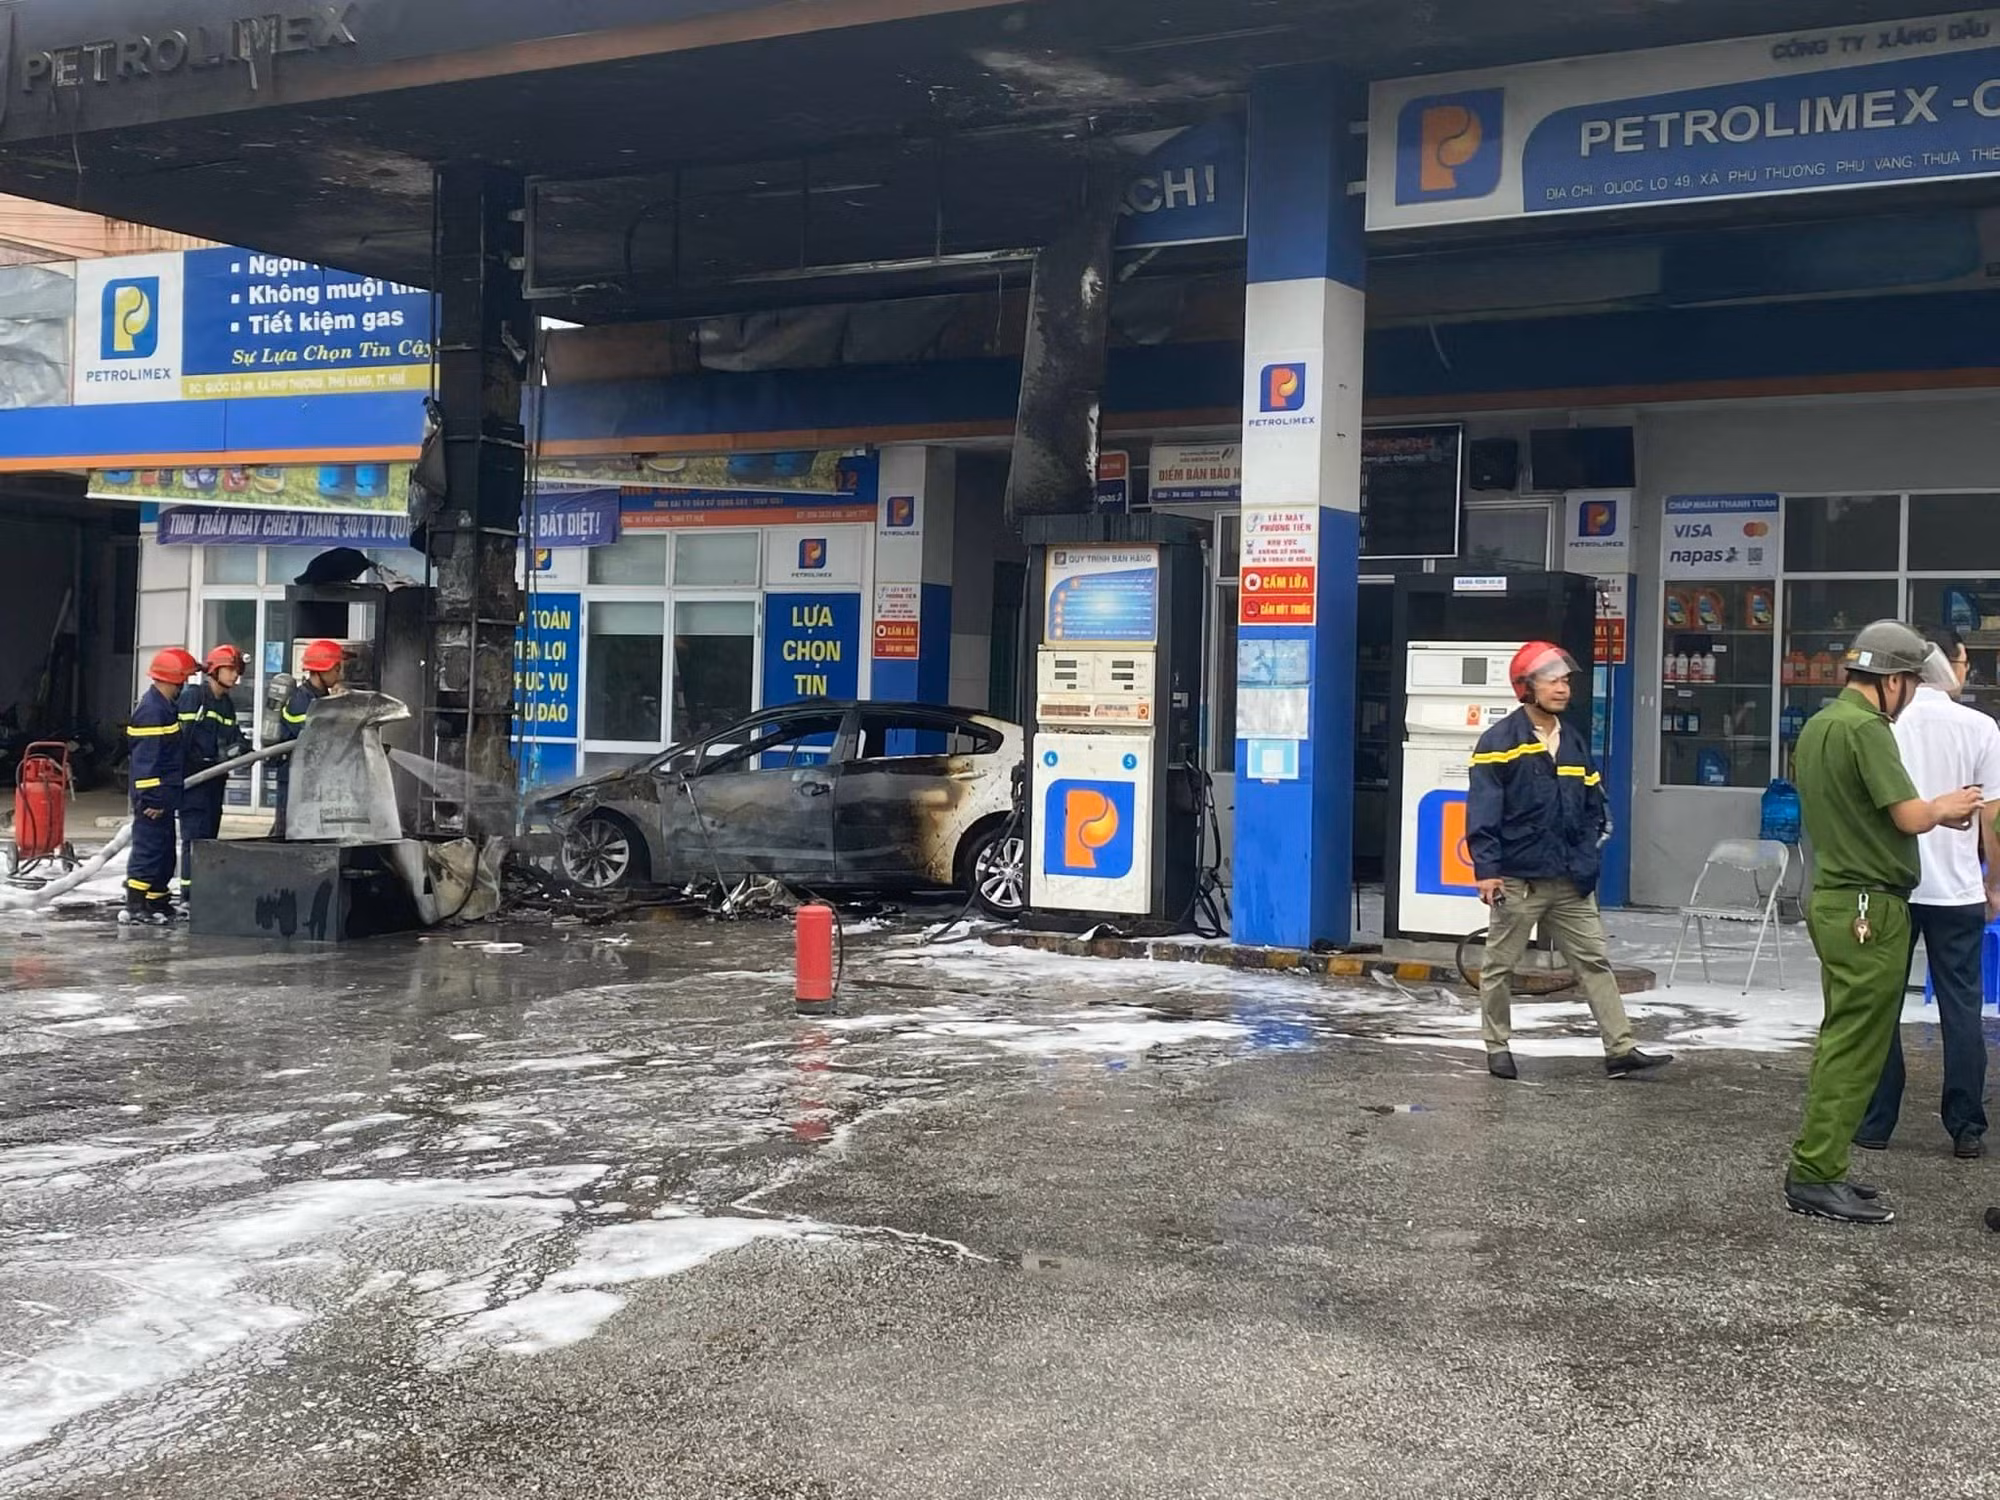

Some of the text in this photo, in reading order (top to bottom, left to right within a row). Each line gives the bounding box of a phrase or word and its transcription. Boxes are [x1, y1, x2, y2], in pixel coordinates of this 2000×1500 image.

[20, 3, 357, 93] PETROLIMEX
[1838, 34, 1866, 53] TY
[1579, 85, 1941, 157] PETROLIMEX
[1120, 164, 1215, 216] CH!
[249, 283, 320, 305] Không
[326, 276, 384, 302] muội
[248, 309, 405, 336] Tiết kiệm gas
[232, 348, 258, 367] Sự
[261, 347, 298, 366] Lựa
[303, 343, 353, 363] Chọn
[359, 341, 391, 358] Tin
[86, 368, 172, 383] PETROLIMEX
[1248, 416, 1316, 428] PETROLIMEX
[169, 513, 196, 535] TINH
[342, 515, 368, 538] 30/4
[540, 505, 564, 537] BẤT
[567, 507, 601, 541] DIỆT!
[1673, 523, 1713, 538] VISA
[1669, 549, 1724, 567] napas
[1262, 572, 1309, 589] CẤM LỬA
[531, 604, 571, 630] TOÀN
[792, 603, 834, 634] LỰA
[544, 641, 567, 667] LỢI
[783, 640, 841, 669] CHỌN
[548, 672, 568, 698] VỤ
[794, 674, 828, 696] TIN
[538, 698, 568, 722] ĐÁO
